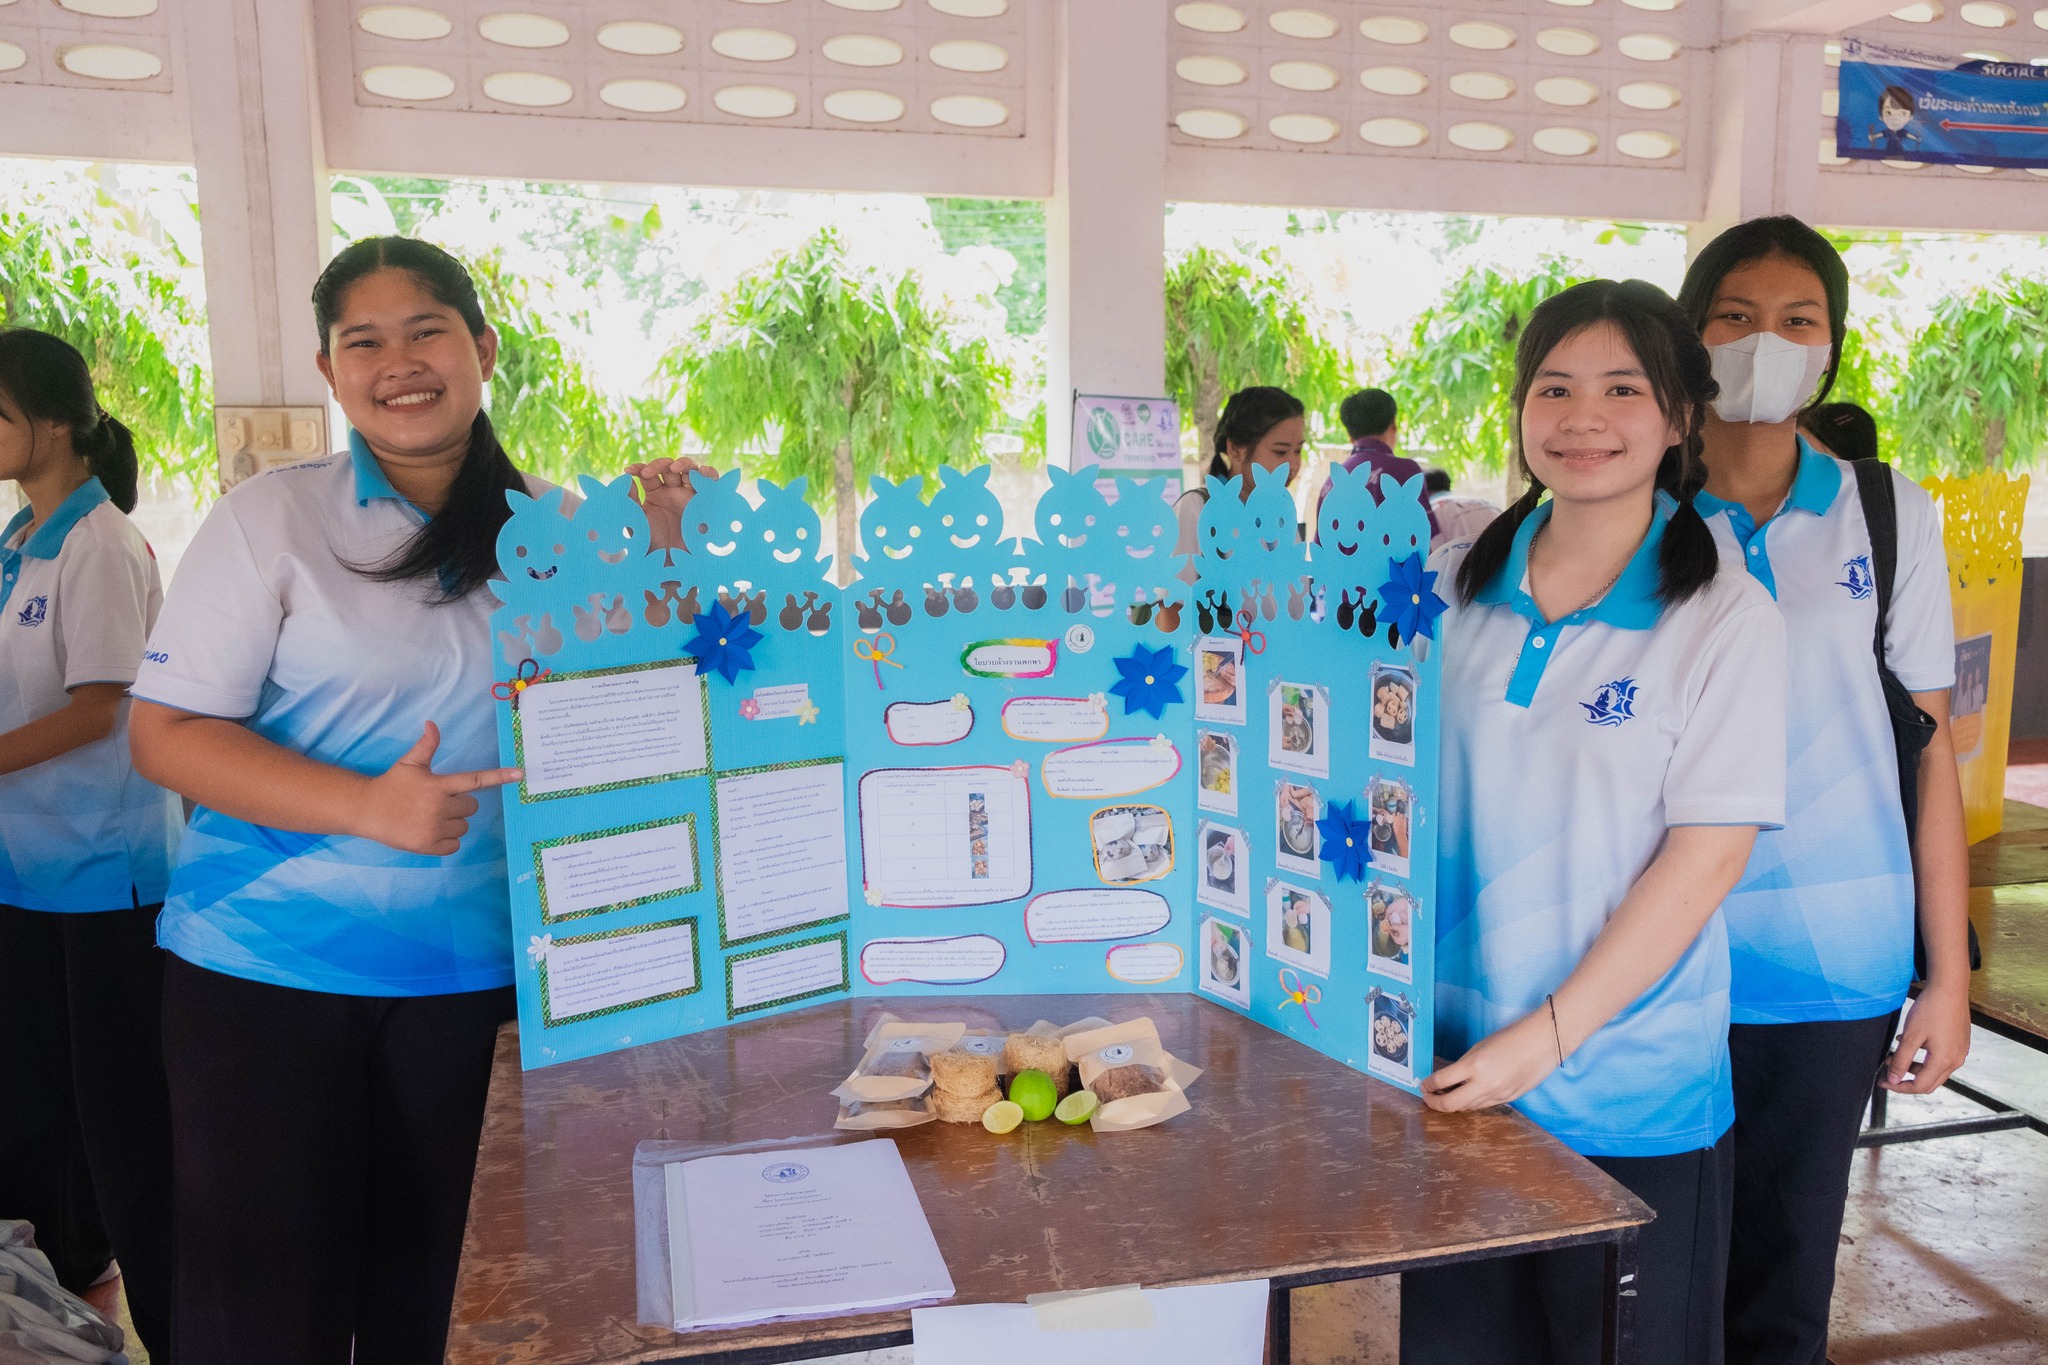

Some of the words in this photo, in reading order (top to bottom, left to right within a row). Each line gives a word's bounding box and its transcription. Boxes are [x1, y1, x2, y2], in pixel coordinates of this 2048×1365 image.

[1981, 63, 2041, 78] SOCIAL
[1918, 91, 2041, 116] เว้นระยะห่างทางสังคม
[1124, 431, 1154, 447] CARE
[974, 657, 1042, 666] ใยบวบล้างจานพกพา
